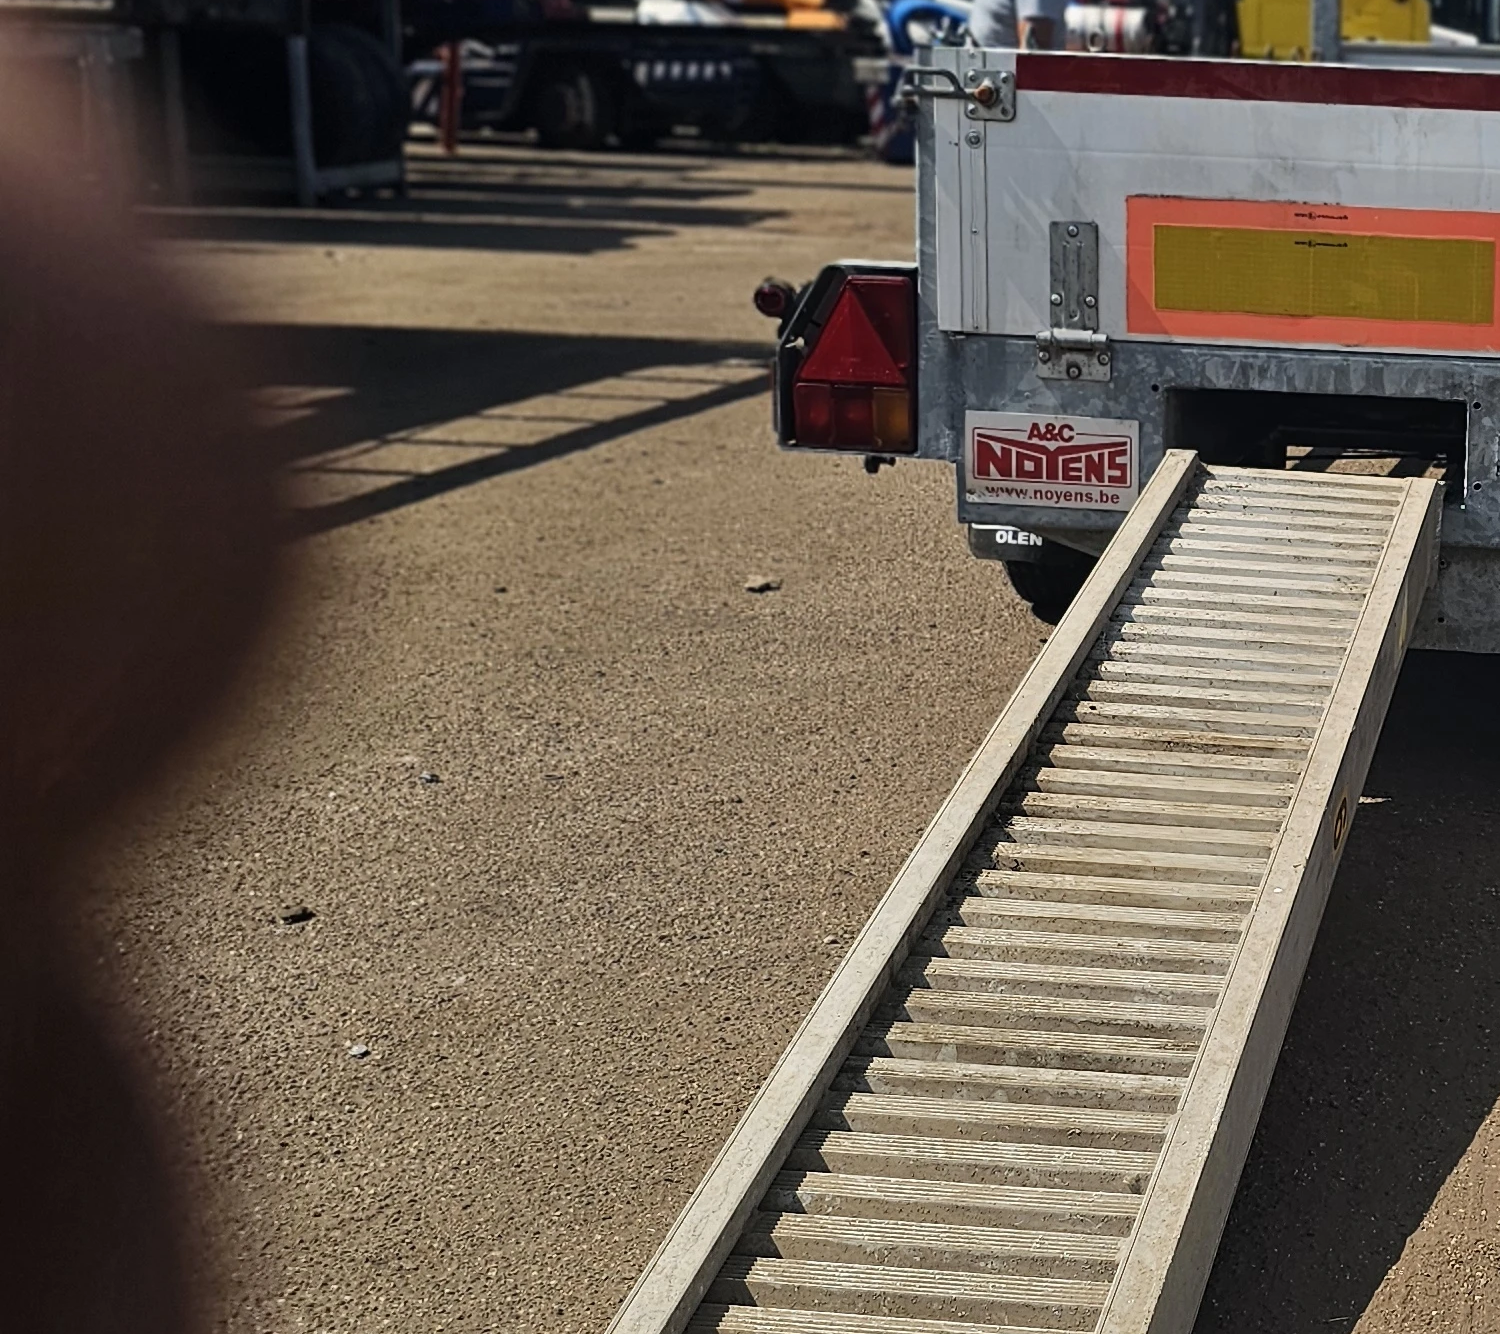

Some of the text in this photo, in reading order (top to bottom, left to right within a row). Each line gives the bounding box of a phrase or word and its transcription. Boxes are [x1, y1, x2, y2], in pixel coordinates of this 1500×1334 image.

[1027, 422, 1075, 443] A&C
[976, 432, 1128, 485] NOYENS
[985, 485, 1120, 504] www.noyens.be
[995, 530, 1043, 546] OLEN
